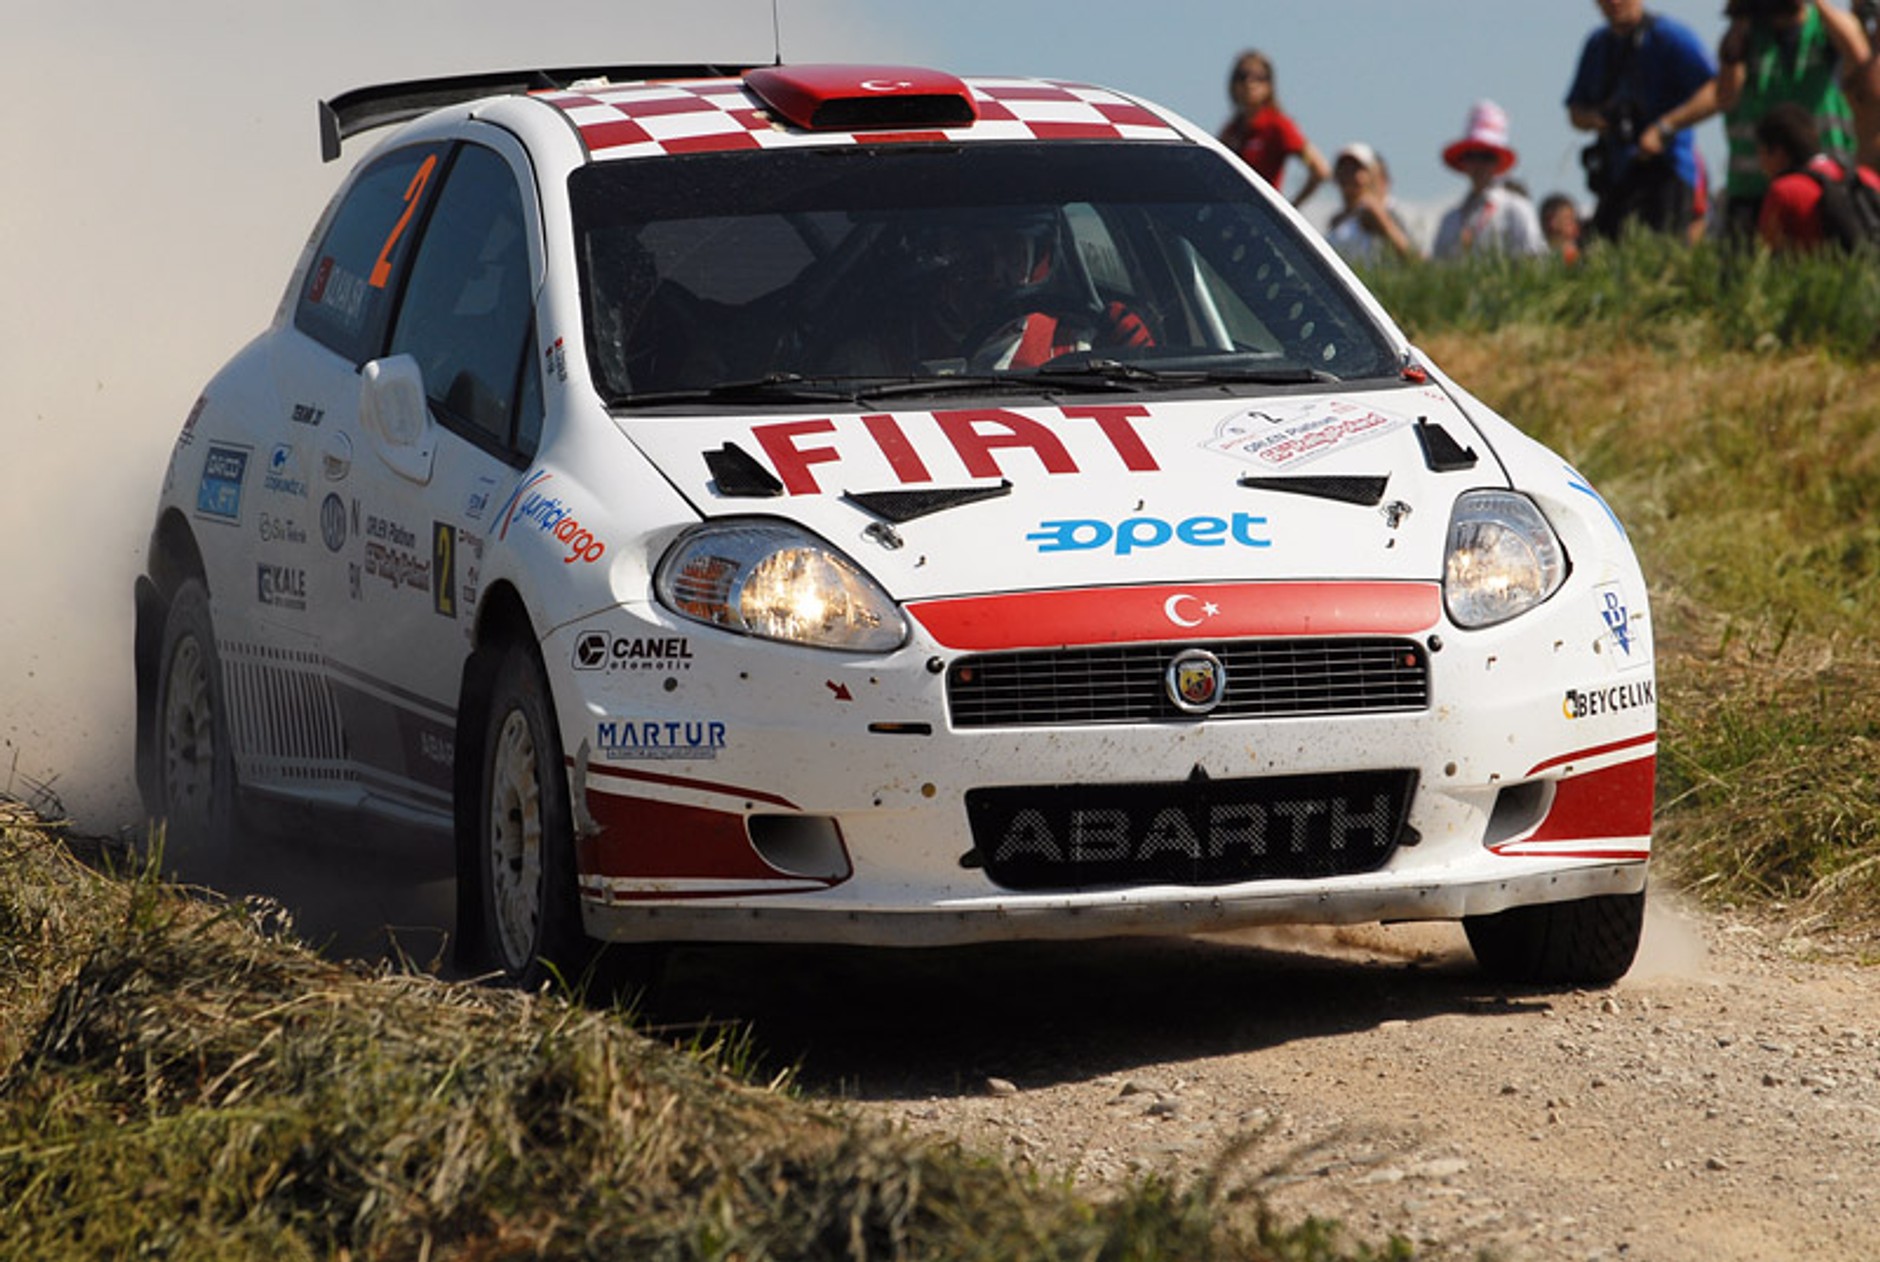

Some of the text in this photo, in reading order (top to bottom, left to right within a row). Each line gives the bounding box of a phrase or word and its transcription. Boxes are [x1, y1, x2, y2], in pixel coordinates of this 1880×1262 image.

[368, 154, 437, 288] 2
[750, 405, 1161, 496] FIAT
[1026, 512, 1272, 555] opet
[272, 565, 305, 597] KALE
[437, 526, 452, 615] 2
[610, 660, 691, 671] otomotiv
[612, 638, 693, 659] CANEL
[598, 722, 726, 748] MARTUR
[996, 794, 1391, 863] ABARTH
